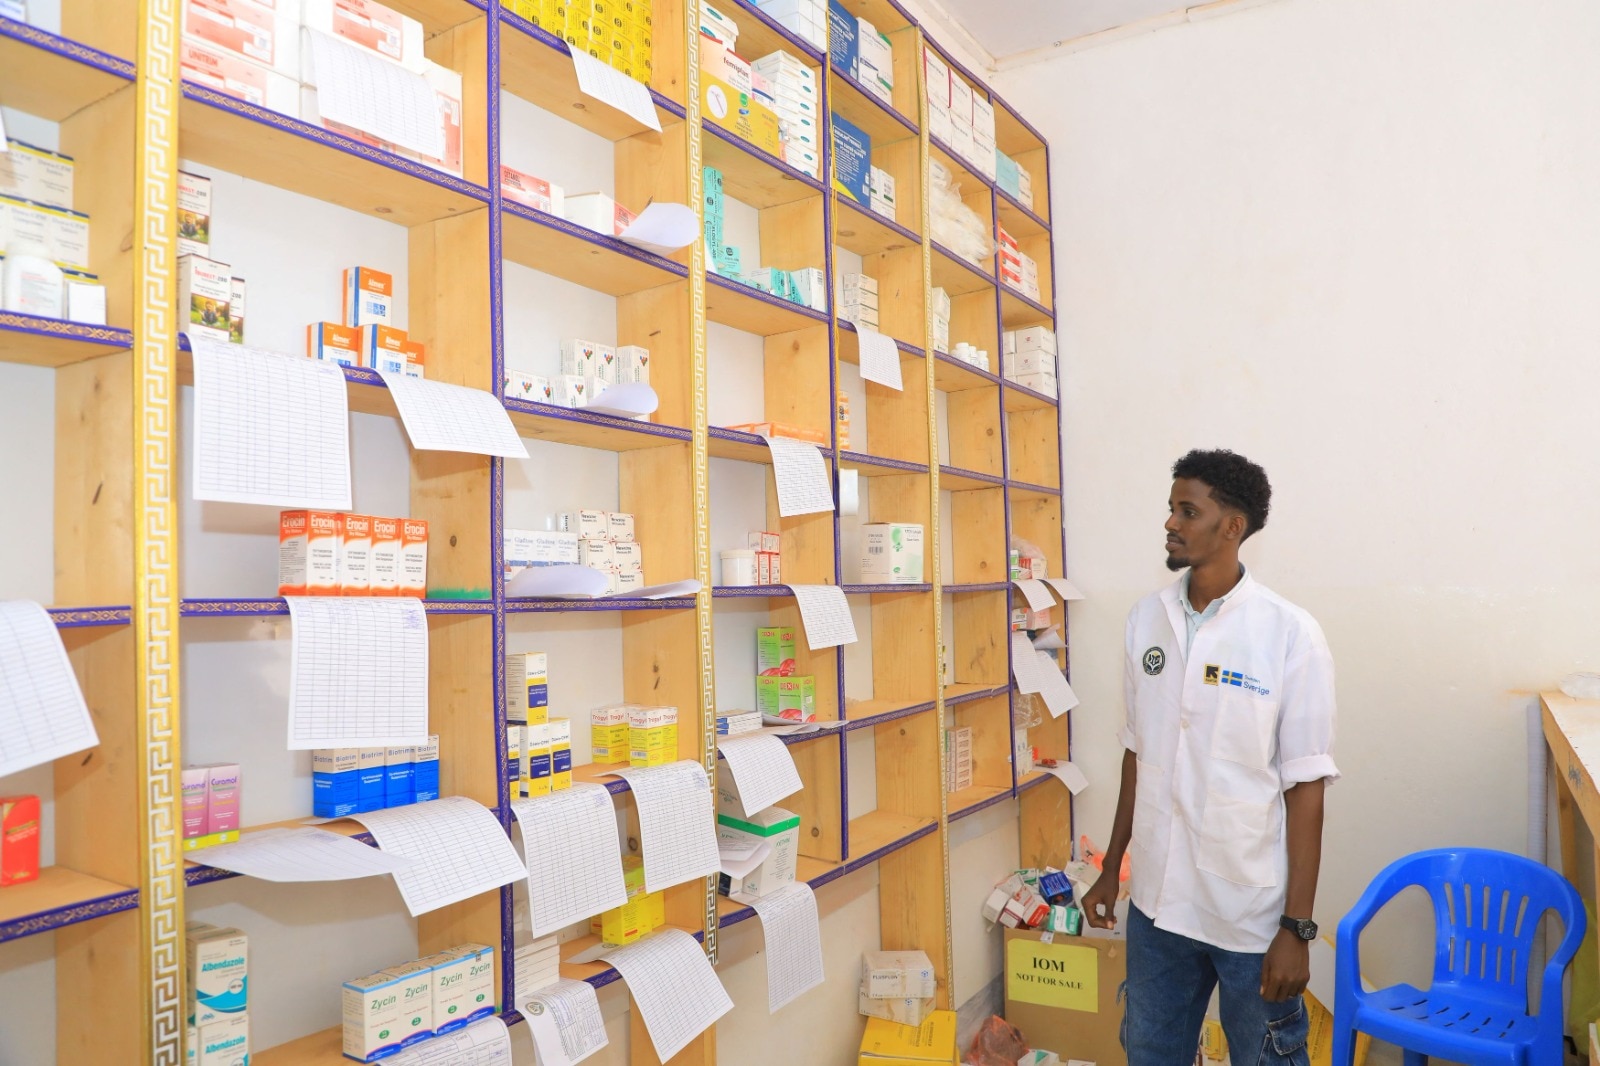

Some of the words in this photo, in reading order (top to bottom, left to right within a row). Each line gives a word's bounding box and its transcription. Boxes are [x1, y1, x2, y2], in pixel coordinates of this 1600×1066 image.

[282, 514, 306, 528] Erocin
[310, 514, 335, 528] Erocin
[346, 517, 369, 531] Erocin
[374, 519, 396, 533] Erocin
[404, 522, 425, 535] Erocin
[1243, 680, 1270, 697] Sverige
[361, 751, 384, 760] Biotrim
[387, 747, 412, 756] Biotrim
[417, 745, 437, 753] Biotrim
[313, 754, 333, 764] Biotrim
[335, 754, 357, 763] Biotrim
[211, 776, 238, 787] Curamol
[201, 956, 246, 974] Albendazole
[470, 962, 491, 977] Zycin
[1032, 956, 1065, 973] IOM
[440, 972, 463, 988] Zycin
[1015, 971, 1036, 983] NOT
[1037, 975, 1056, 988] FOR
[1058, 979, 1084, 991] SALE
[404, 983, 428, 999] Zycin
[370, 993, 397, 1011] Zycin
[204, 1035, 247, 1055] Albendazole
